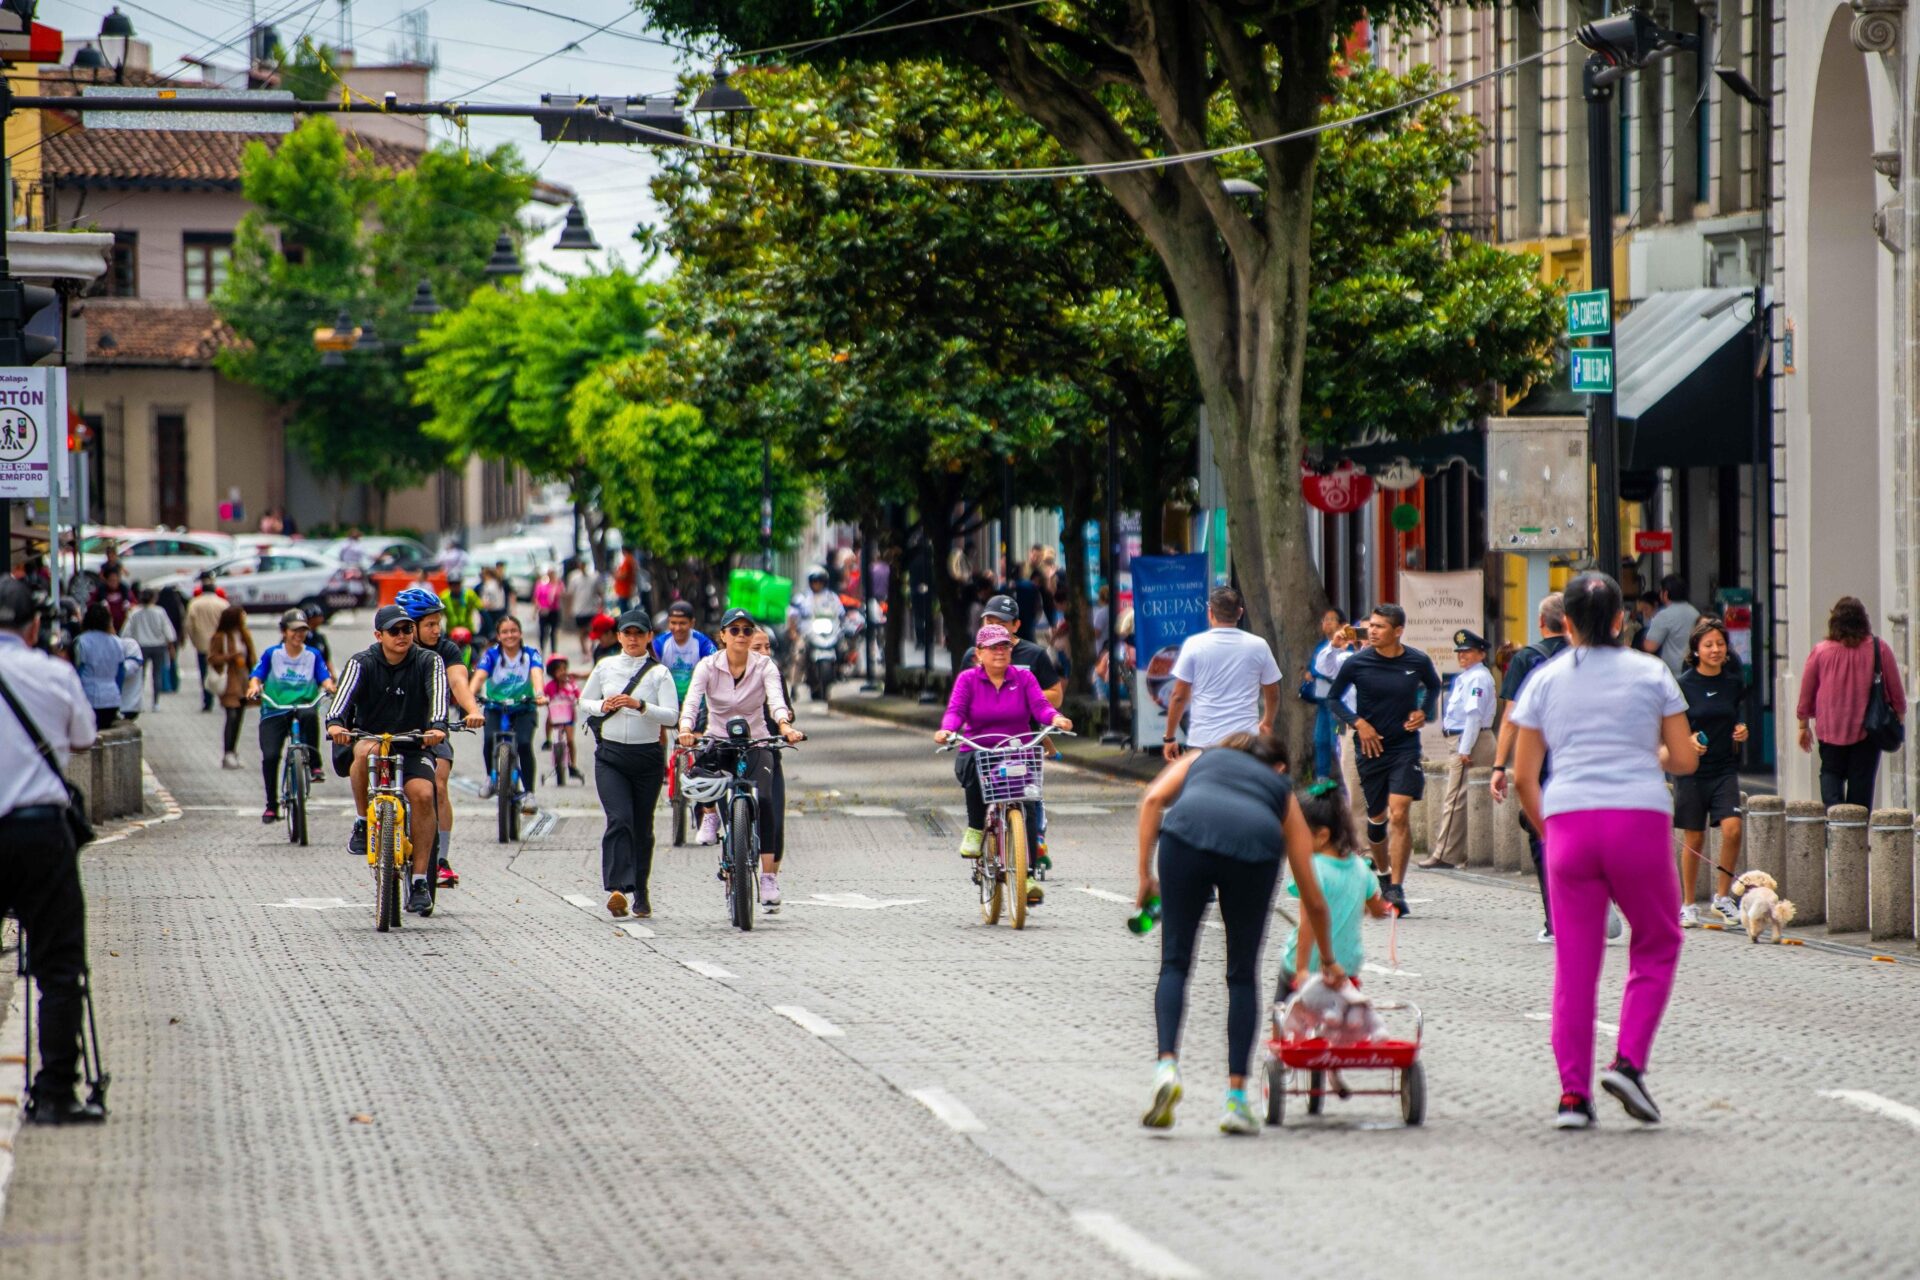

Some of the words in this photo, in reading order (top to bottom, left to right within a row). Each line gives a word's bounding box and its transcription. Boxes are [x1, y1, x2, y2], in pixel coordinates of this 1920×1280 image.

[15, 463, 31, 471] CON
[1142, 596, 1205, 617] CREPAS
[1418, 597, 1437, 609] DON
[1438, 597, 1464, 608] JUSTO
